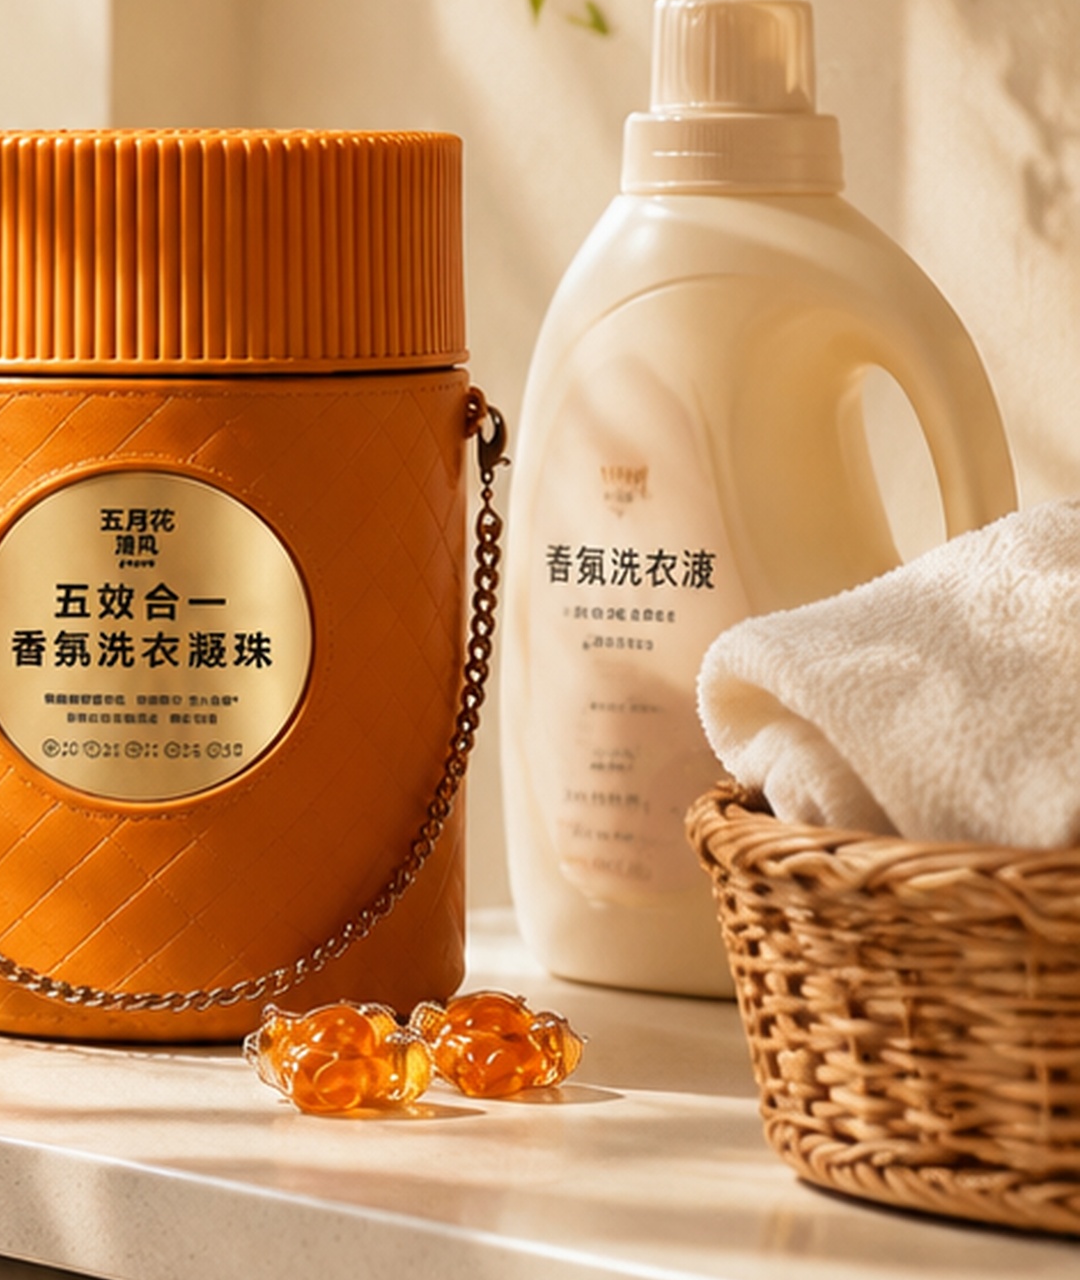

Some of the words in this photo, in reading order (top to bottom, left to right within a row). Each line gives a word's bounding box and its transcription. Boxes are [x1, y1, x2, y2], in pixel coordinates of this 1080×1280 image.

[100, 508, 175, 532] 五月花
[54, 582, 226, 621] 五效合一
